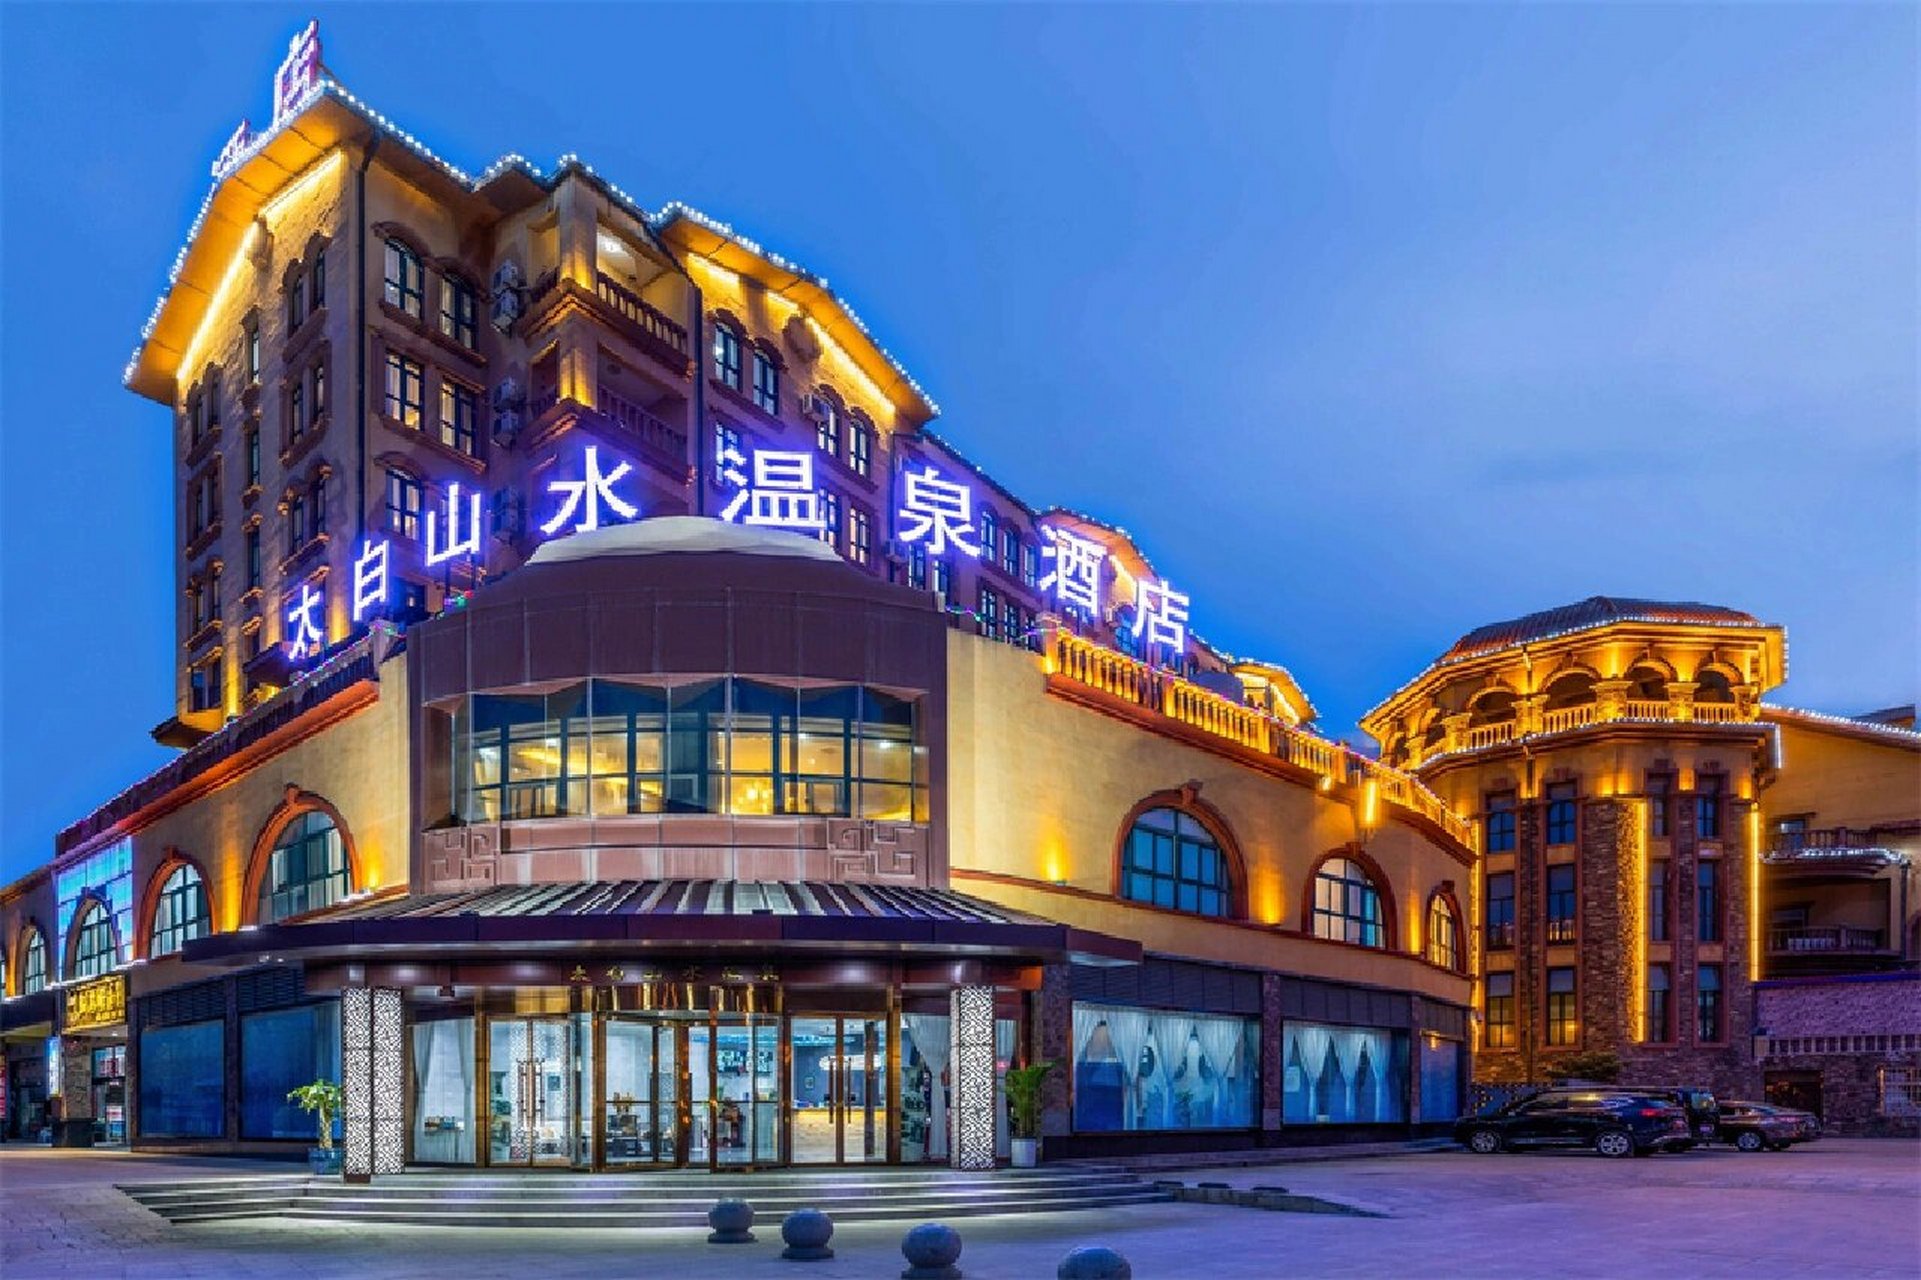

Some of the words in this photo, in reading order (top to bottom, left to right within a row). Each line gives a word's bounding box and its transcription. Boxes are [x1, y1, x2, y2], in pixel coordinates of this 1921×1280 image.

[288, 446, 1190, 660] 太白山水温泉酒店
